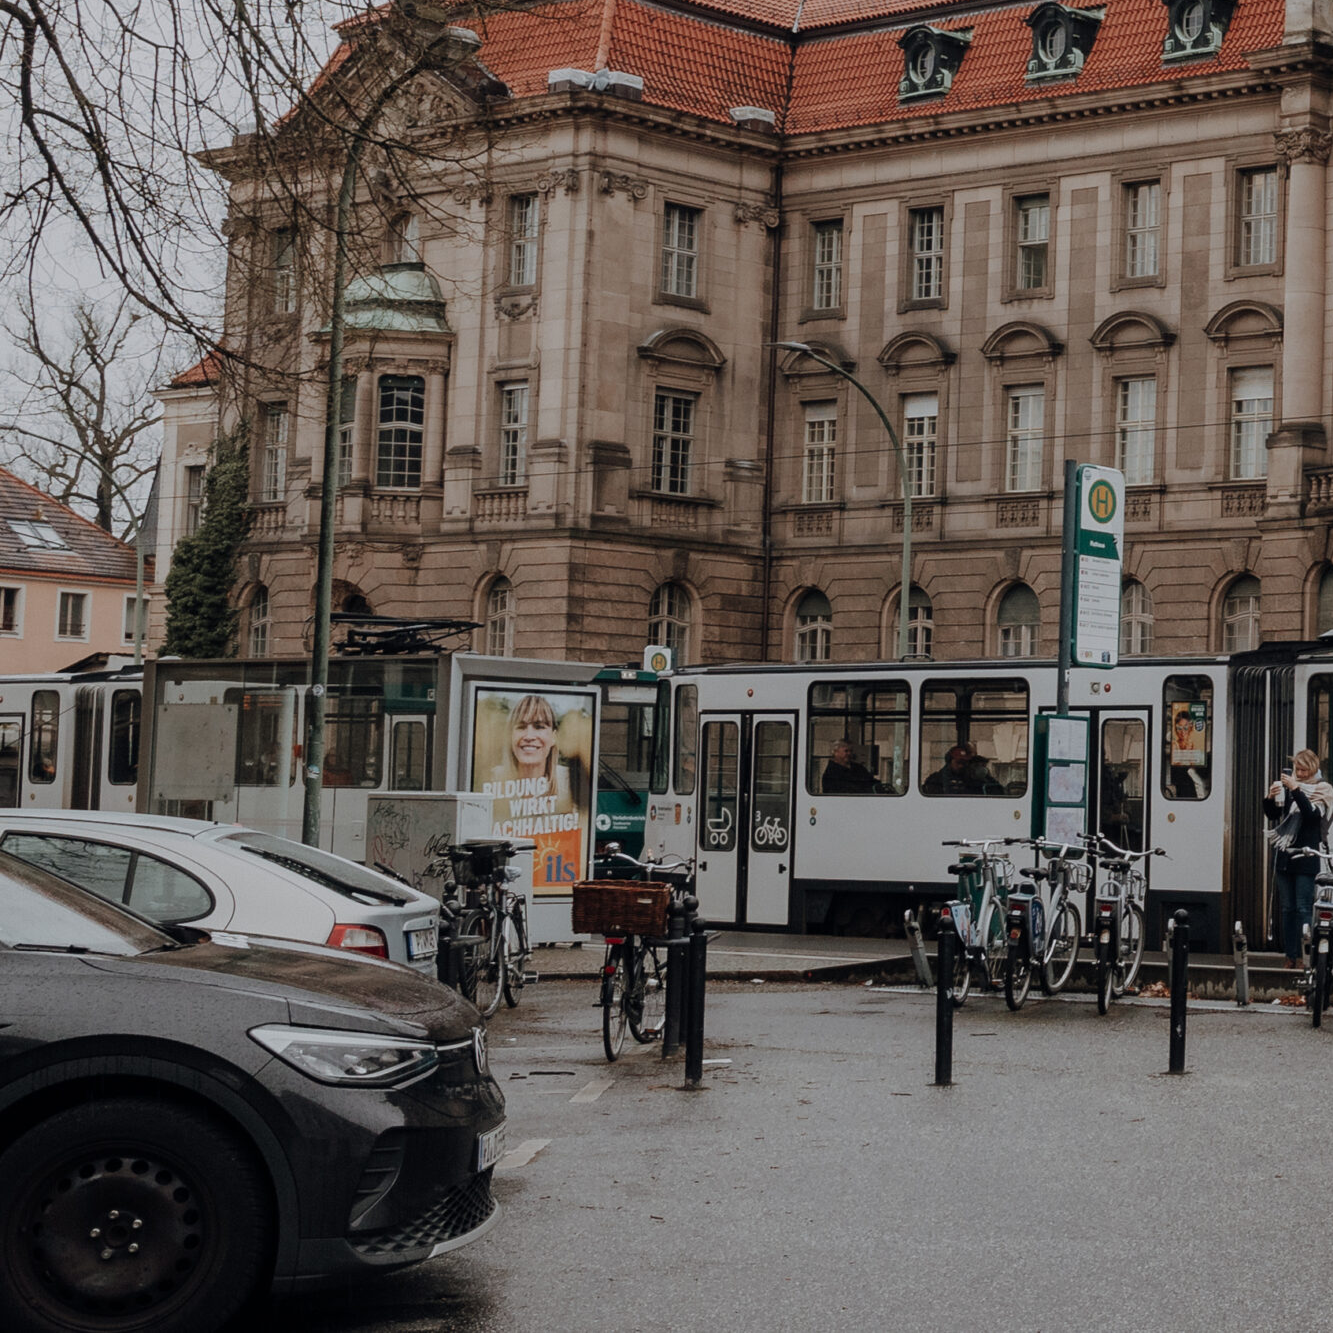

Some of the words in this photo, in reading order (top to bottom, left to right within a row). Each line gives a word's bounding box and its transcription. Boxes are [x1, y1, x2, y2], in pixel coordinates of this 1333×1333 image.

[482, 777, 549, 800] BILDUNG
[509, 795, 558, 818] WIRKT
[755, 810, 762, 822] 3
[492, 812, 580, 838] ACHHALTIG!
[545, 854, 576, 883] ils
